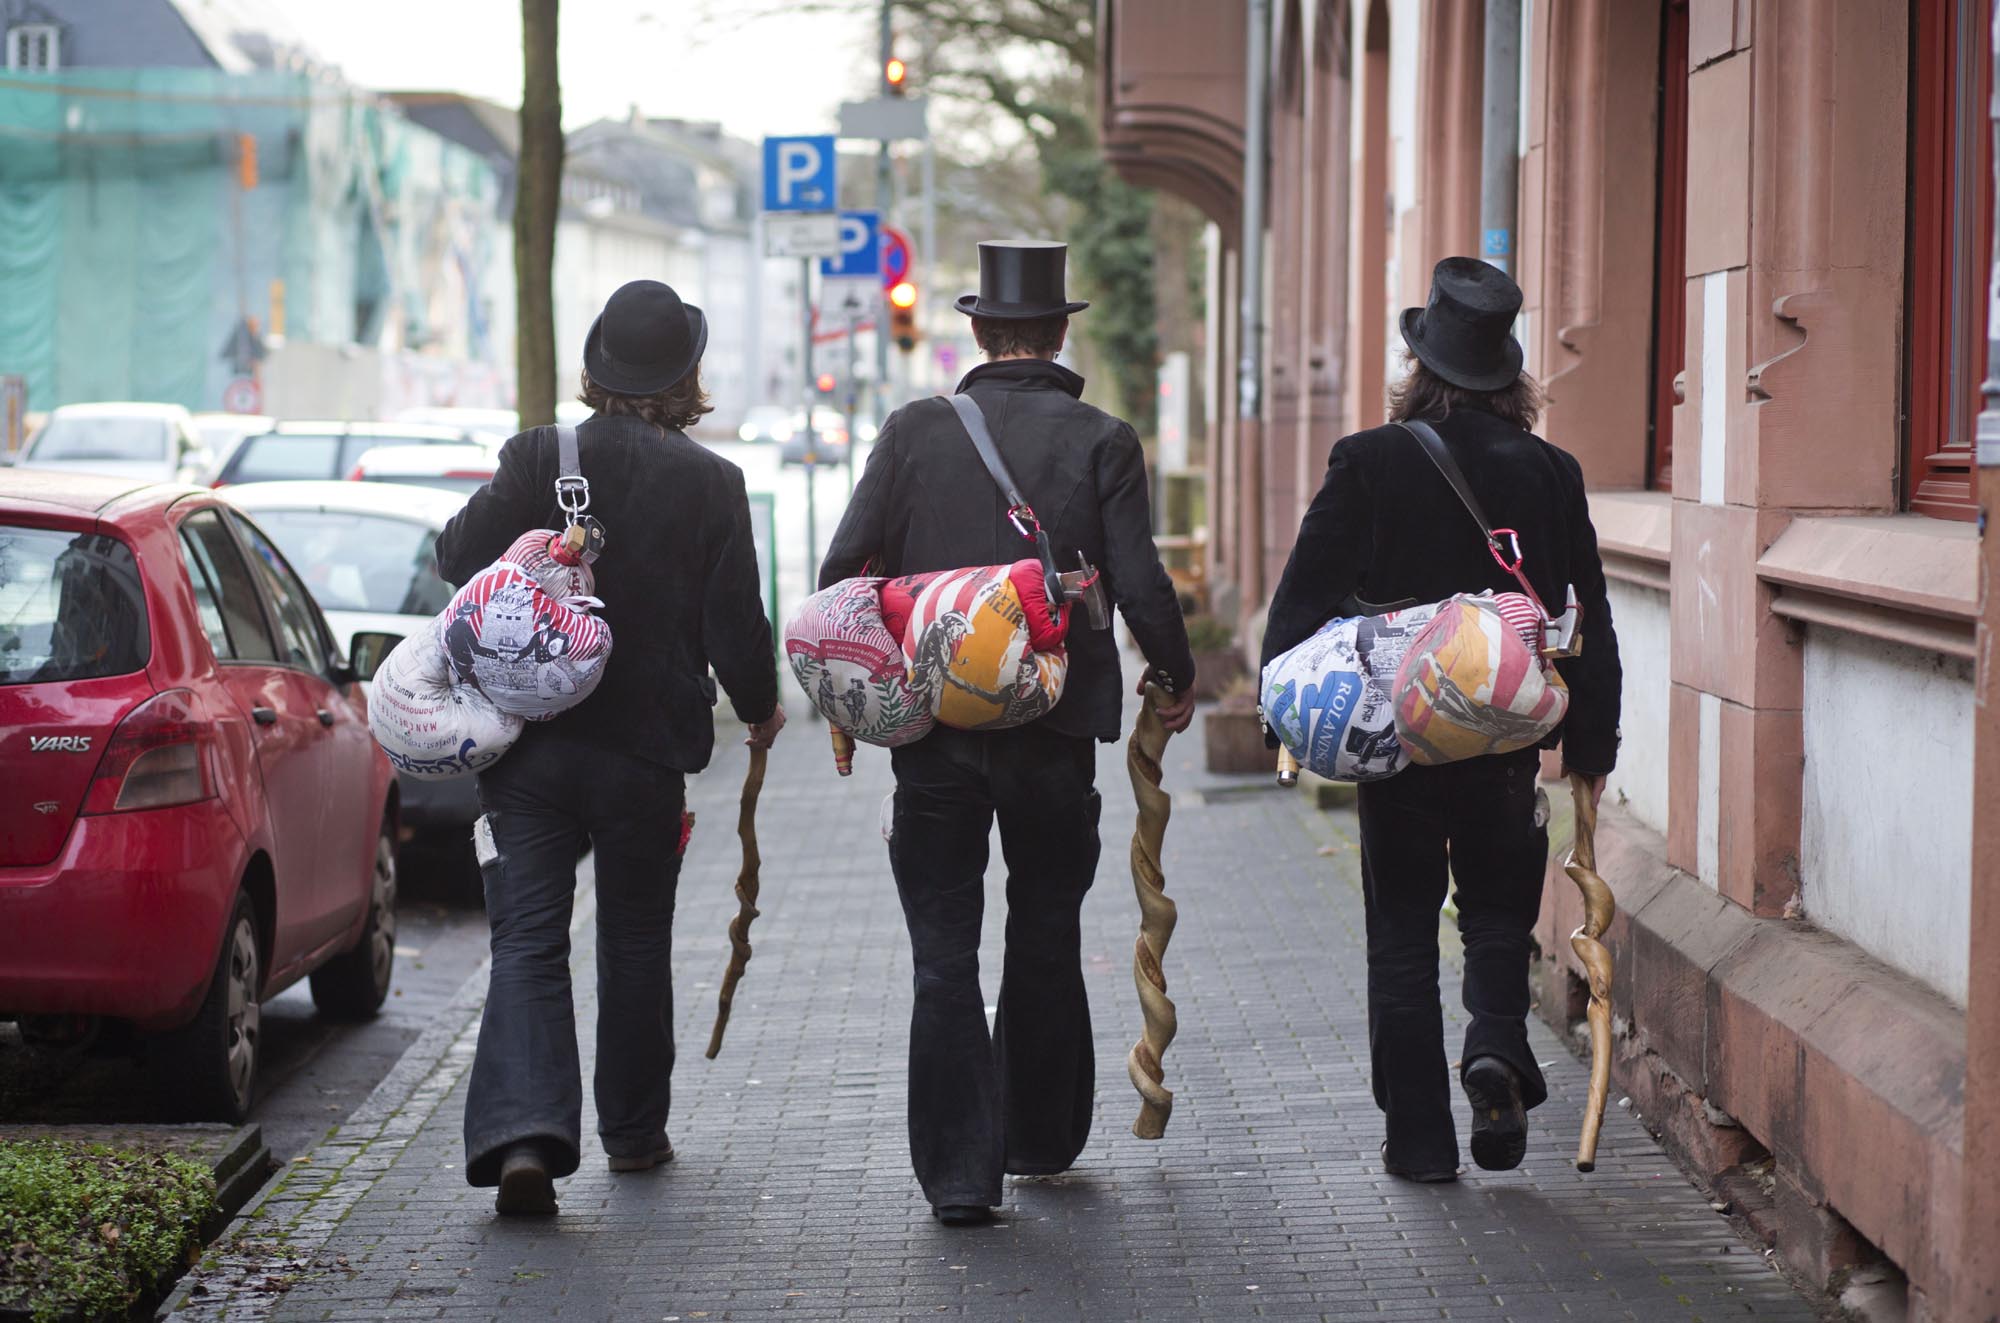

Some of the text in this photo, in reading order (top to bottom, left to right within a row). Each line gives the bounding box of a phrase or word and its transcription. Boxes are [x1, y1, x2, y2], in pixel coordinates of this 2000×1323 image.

[777, 141, 821, 204] P
[830, 217, 869, 272] P
[30, 735, 92, 752] YARIS
